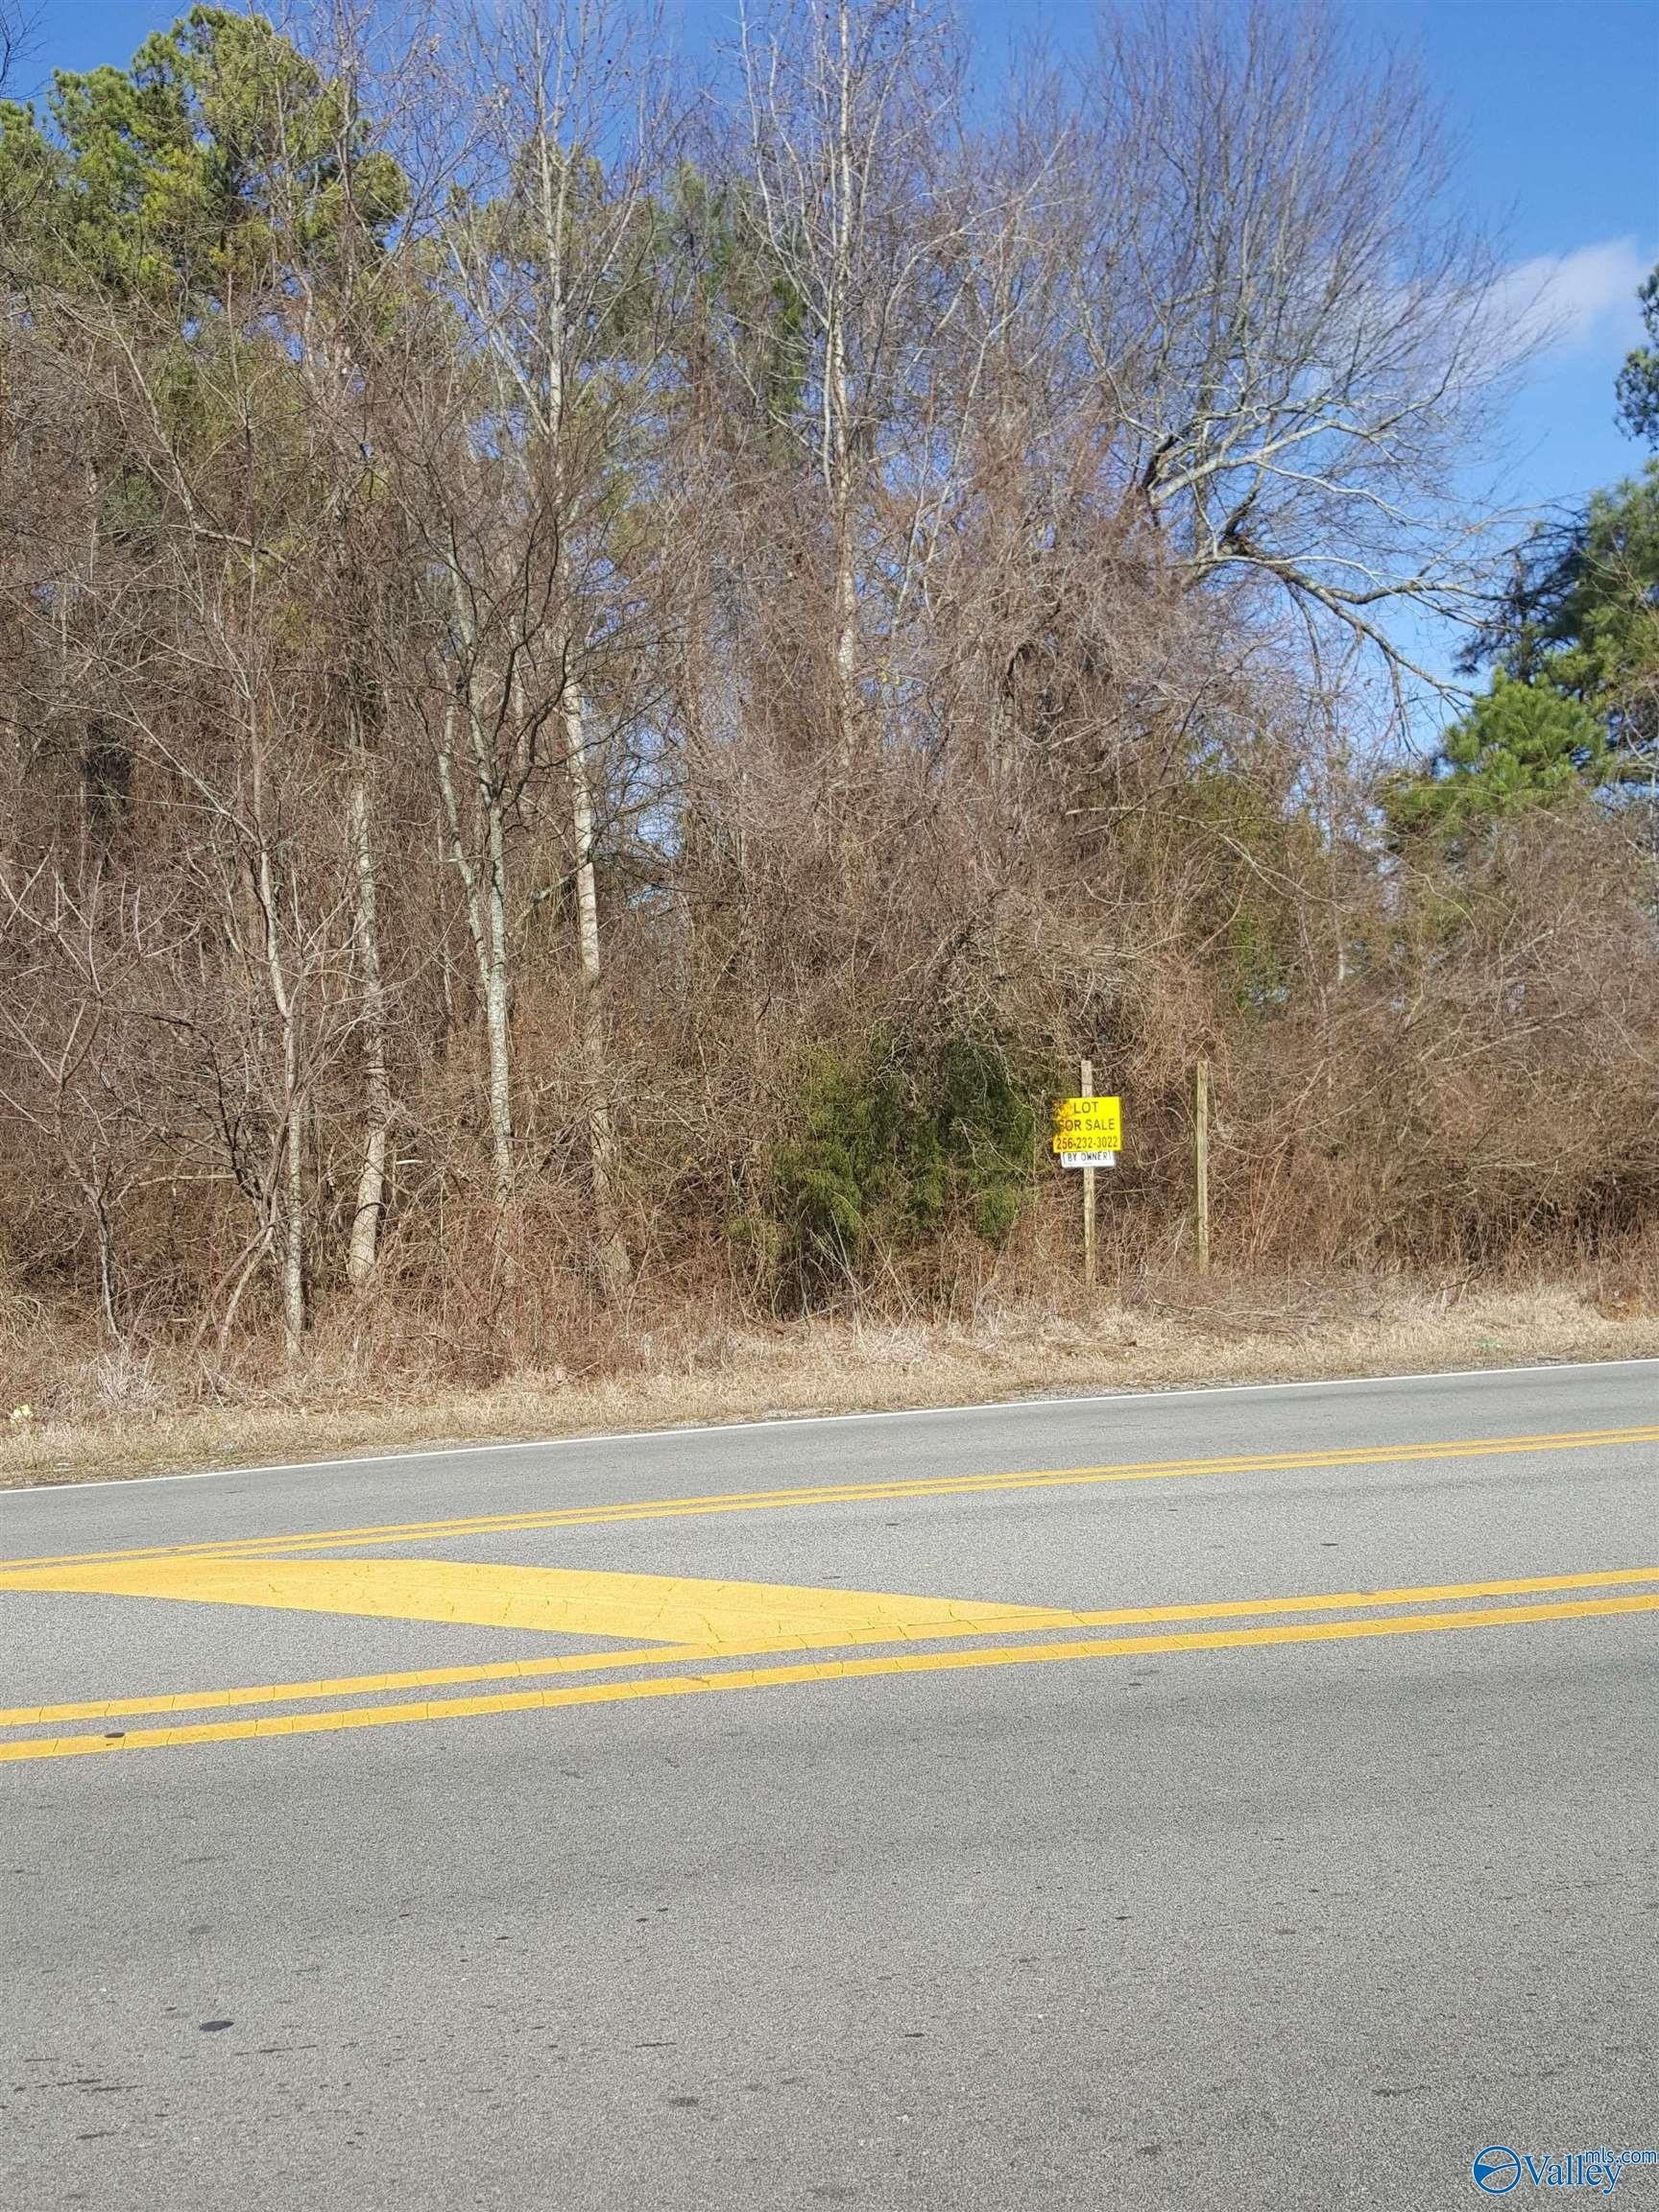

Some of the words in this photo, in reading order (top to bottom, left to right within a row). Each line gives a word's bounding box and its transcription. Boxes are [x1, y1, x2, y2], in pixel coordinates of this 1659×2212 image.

[1073, 1101, 1098, 1114] LOT
[1059, 1119, 1082, 1132] FOR
[1086, 1118, 1115, 1131] SALE
[1057, 1136, 1118, 1150] 256-232-3022
[1067, 1153, 1077, 1162] BY
